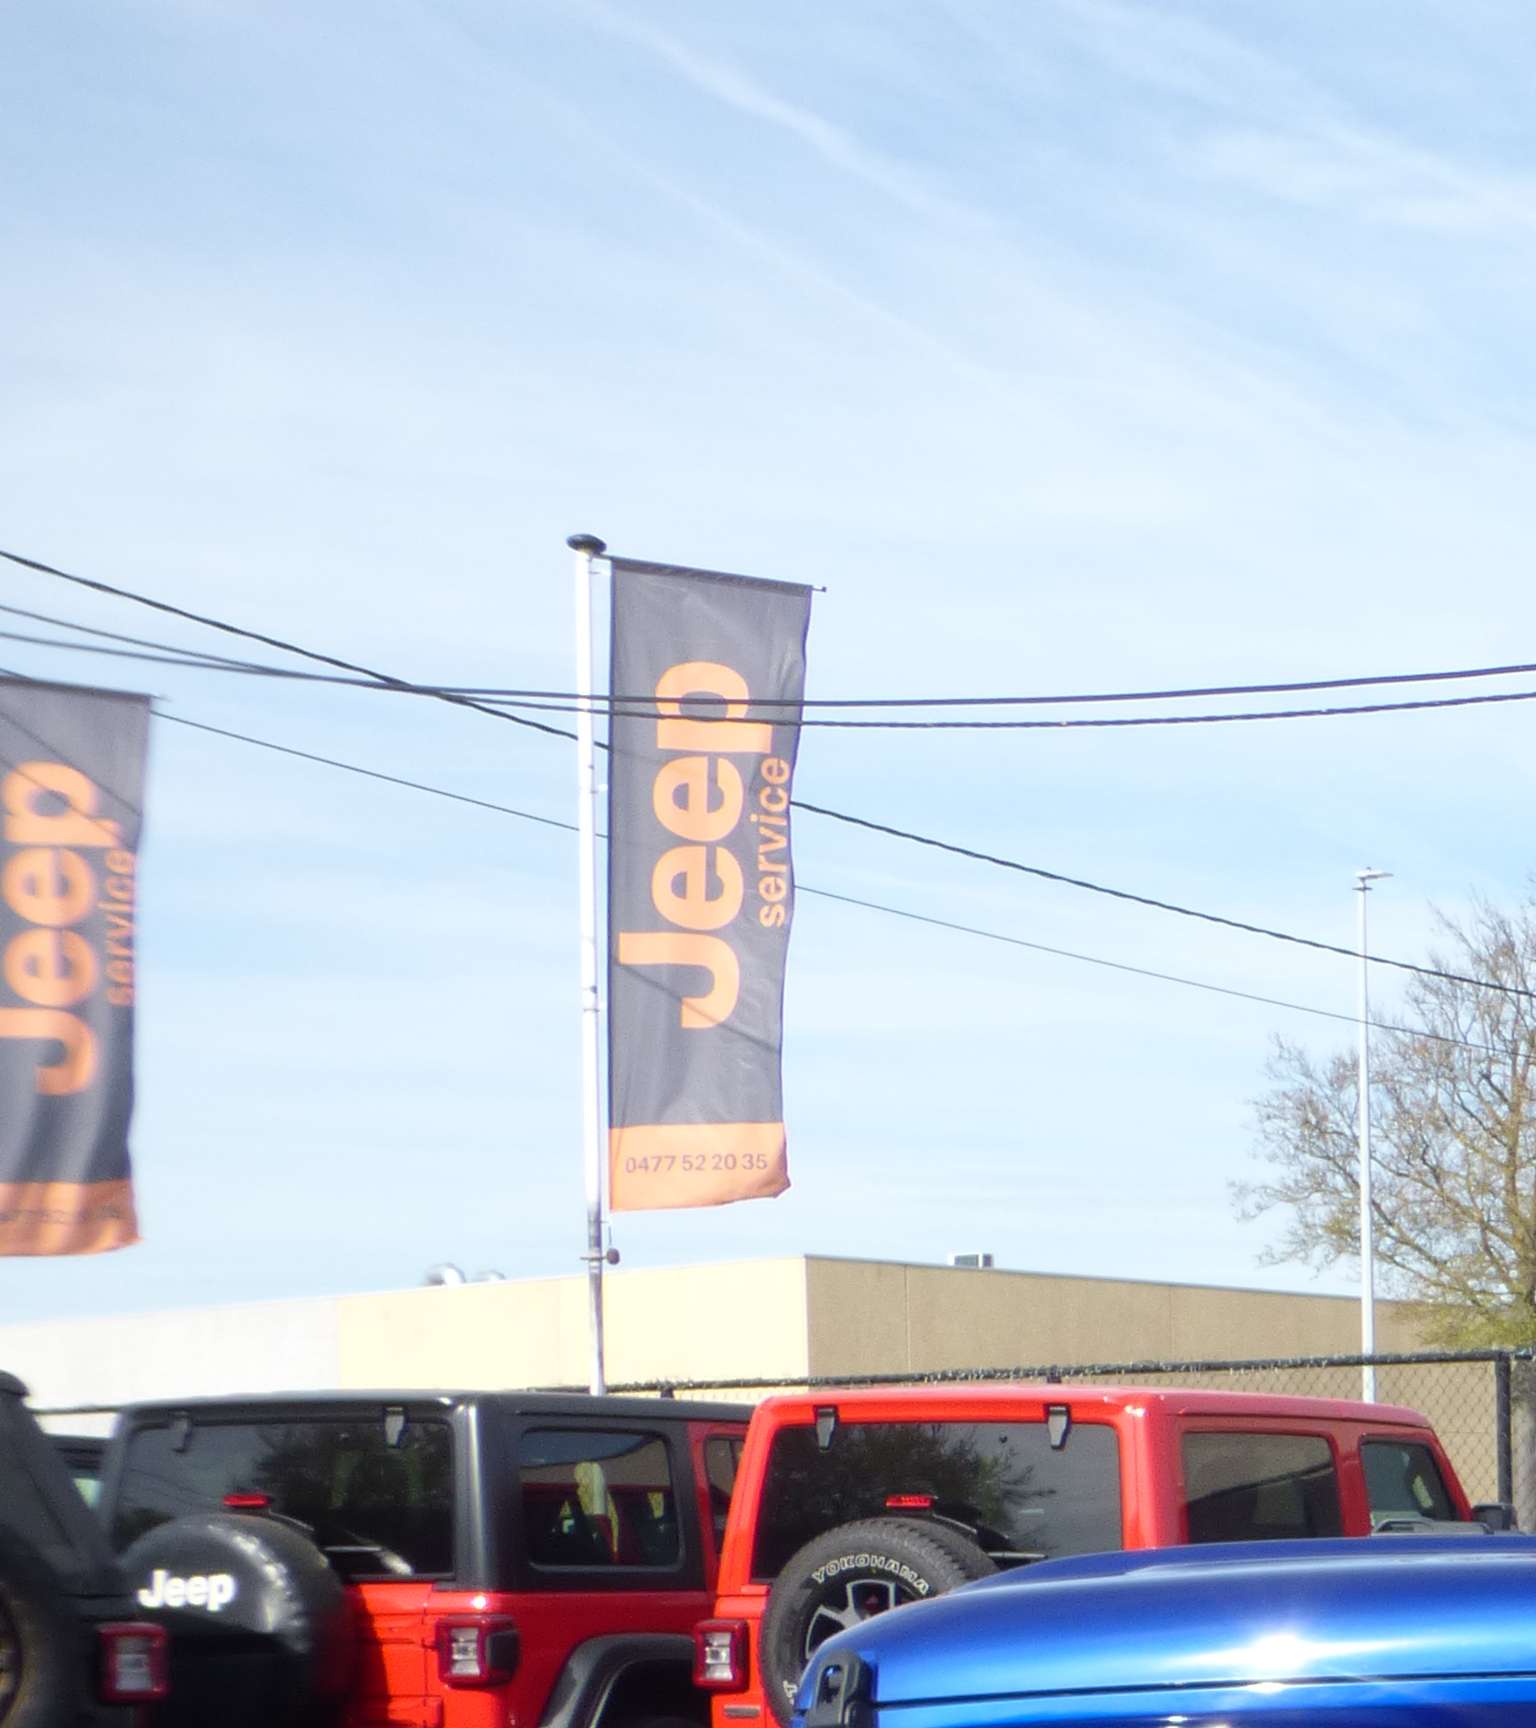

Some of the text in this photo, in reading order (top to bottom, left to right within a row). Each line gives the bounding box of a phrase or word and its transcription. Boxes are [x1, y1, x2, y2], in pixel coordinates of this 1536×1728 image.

[619, 661, 774, 1029] Jeep
[751, 757, 791, 929] service
[0, 760, 121, 1096] Jeep
[99, 851, 135, 1006] service
[625, 1153, 768, 1173] 0477 52 20 35
[137, 1569, 236, 1612] Jeep
[811, 1553, 930, 1596] YOKOHAMA
